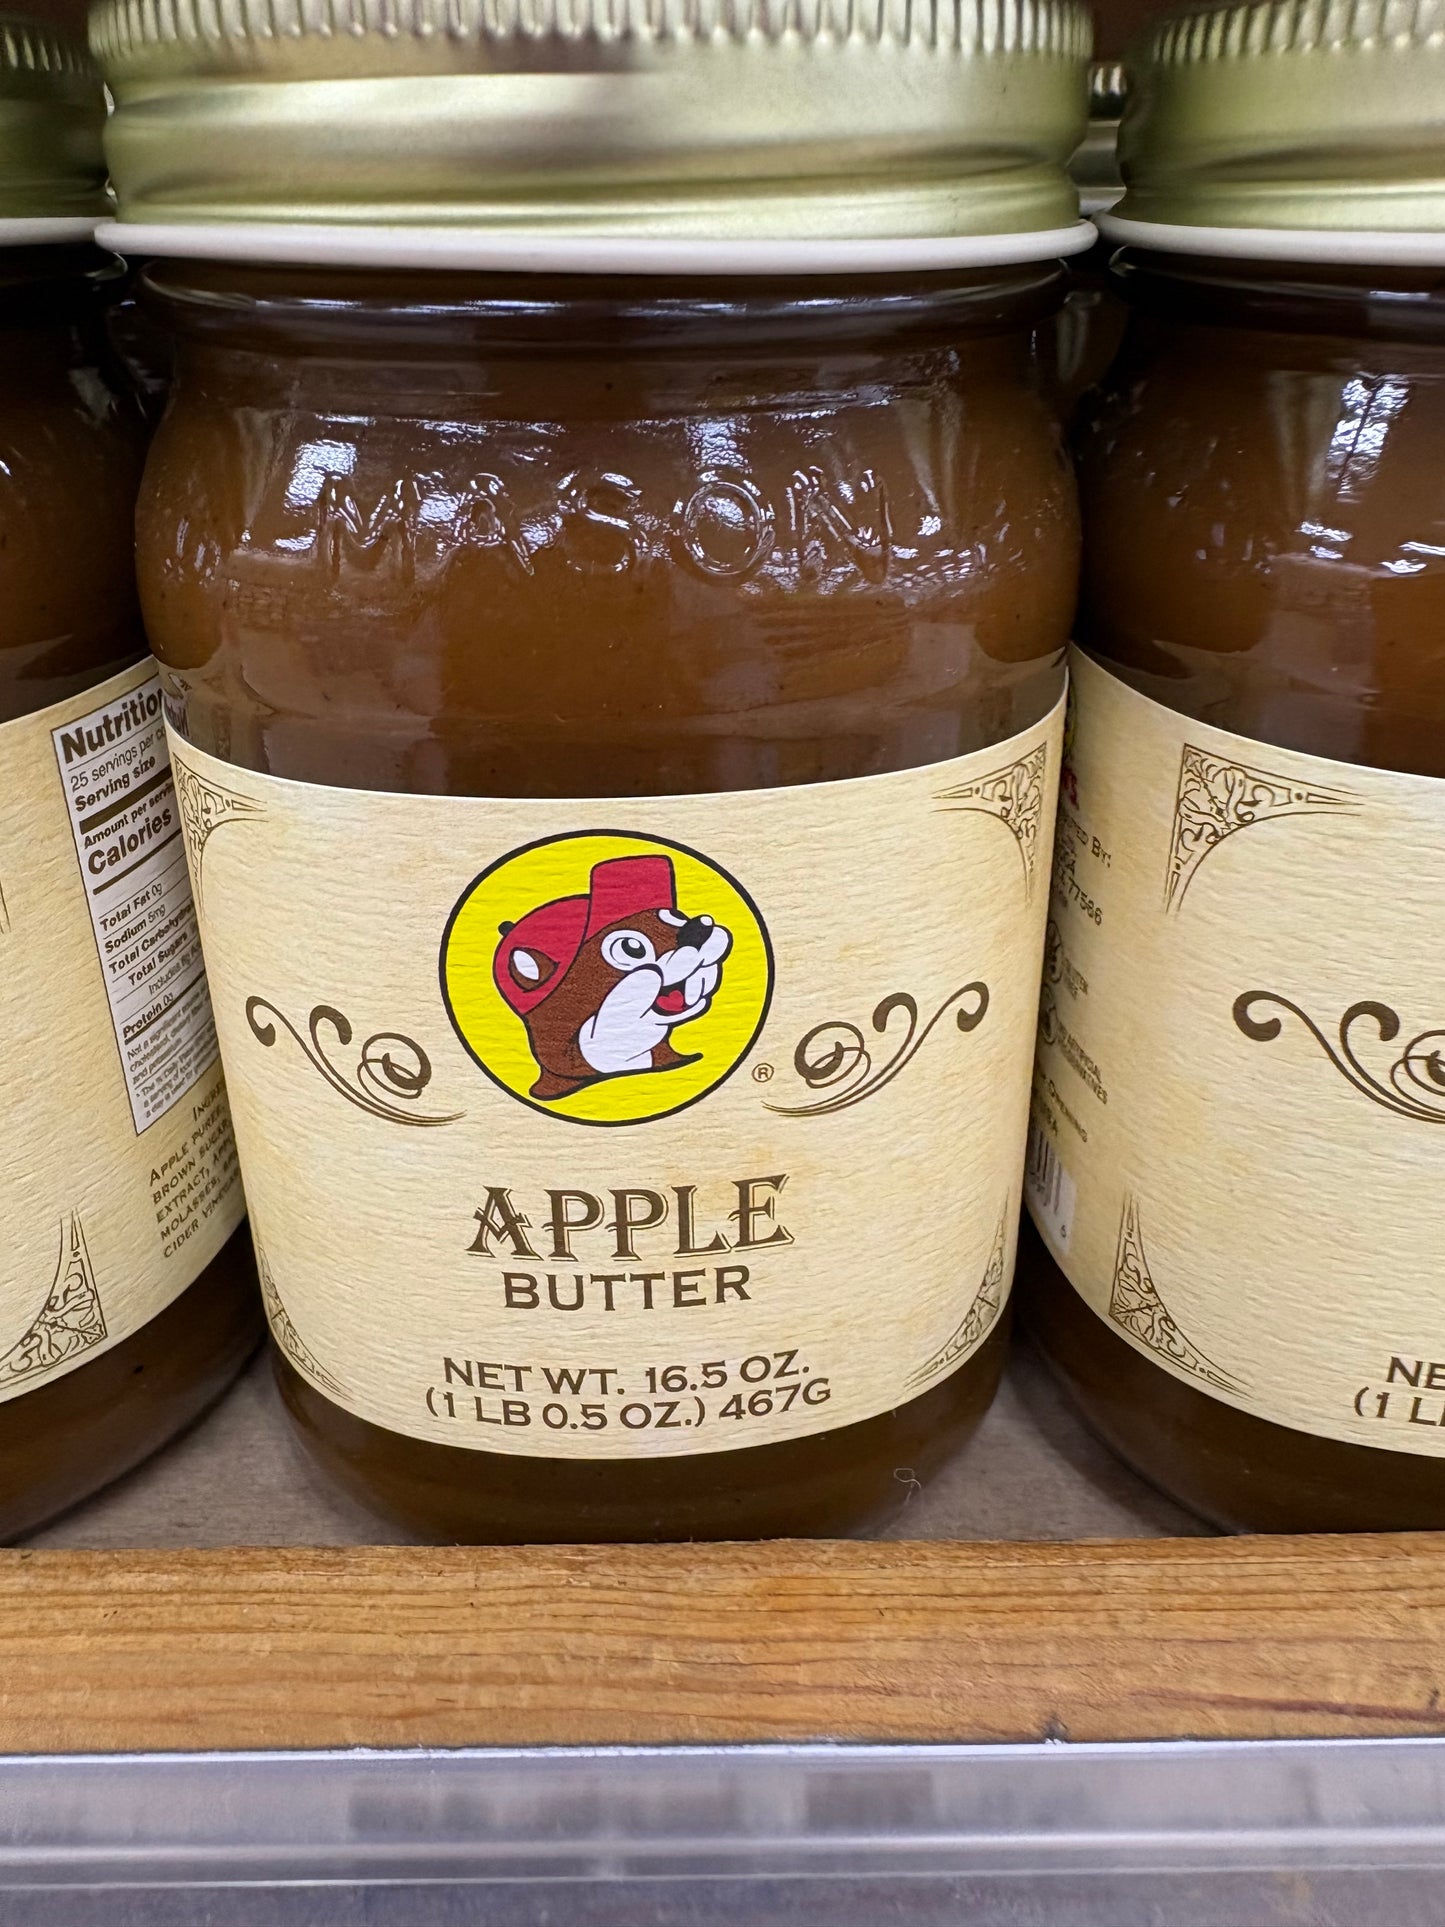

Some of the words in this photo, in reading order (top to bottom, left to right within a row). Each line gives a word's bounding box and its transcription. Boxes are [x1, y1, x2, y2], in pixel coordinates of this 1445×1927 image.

[70, 771, 89, 793] 25
[91, 746, 138, 782] servings
[139, 733, 154, 756] per
[75, 773, 130, 812] Serving
[132, 756, 156, 779] size
[84, 814, 129, 849] Amount
[130, 803, 147, 823] per
[88, 808, 172, 875] Calories
[99, 904, 131, 931] Total
[133, 890, 150, 910] Fat
[104, 919, 147, 954] Sodium
[109, 946, 140, 974] Total
[128, 957, 156, 986] Total
[123, 1004, 162, 1038] Protein
[150, 1142, 189, 1187] APPLE
[153, 1157, 196, 1205] BROWN
[156, 1165, 210, 1225] EXTRACT,
[465, 1173, 795, 1262] APPLE
[163, 1217, 199, 1259] CIDER
[501, 1265, 752, 1312] BUTTER
[443, 1357, 532, 1392] NET
[541, 1366, 626, 1395] WT.
[645, 1360, 728, 1394] 16.5
[740, 1349, 810, 1383] OZ.
[425, 1386, 457, 1418] (1
[474, 1396, 531, 1427] LB
[542, 1402, 608, 1430] 0.5
[619, 1396, 706, 1428] OZ.)
[718, 1378, 832, 1421] 467G
[1354, 1386, 1391, 1418] (1
